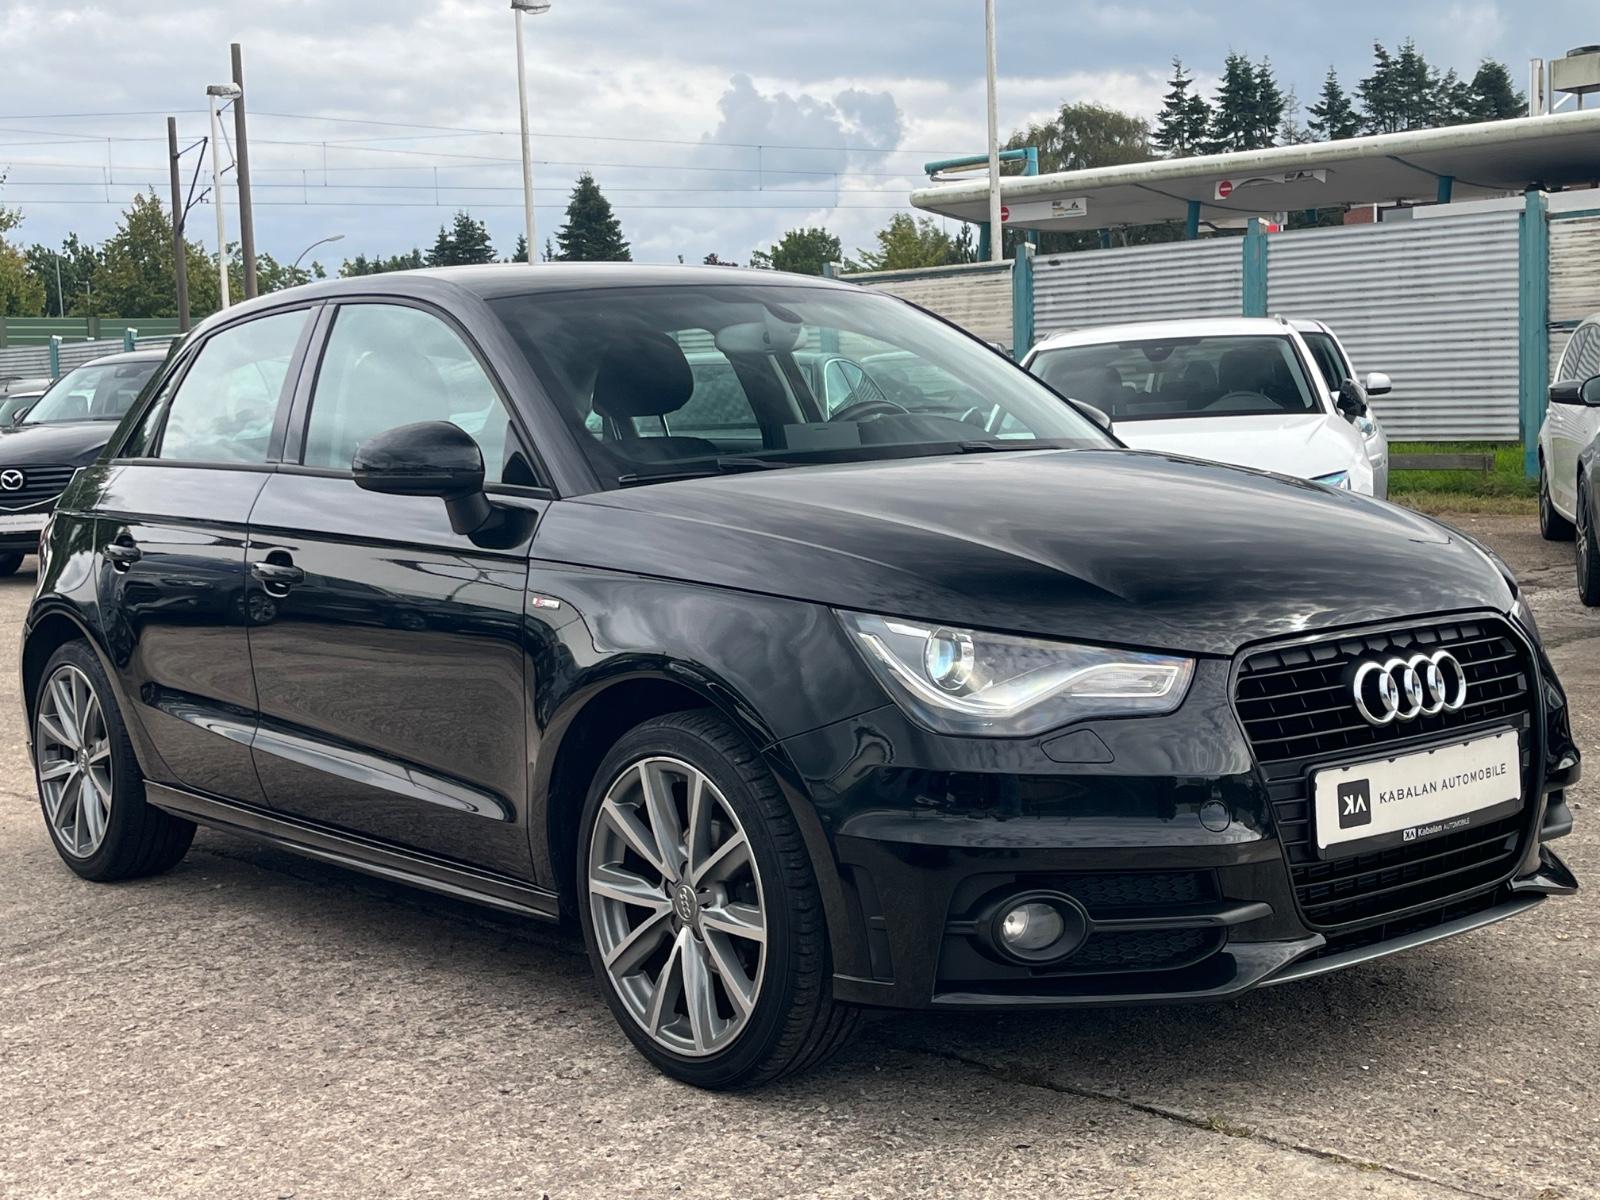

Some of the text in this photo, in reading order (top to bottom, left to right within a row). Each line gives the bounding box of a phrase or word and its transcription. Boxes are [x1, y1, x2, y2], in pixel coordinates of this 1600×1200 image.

[1379, 763, 1506, 804] KABALAN AUTOMOBILE
[1418, 824, 1442, 837] Kabalan
